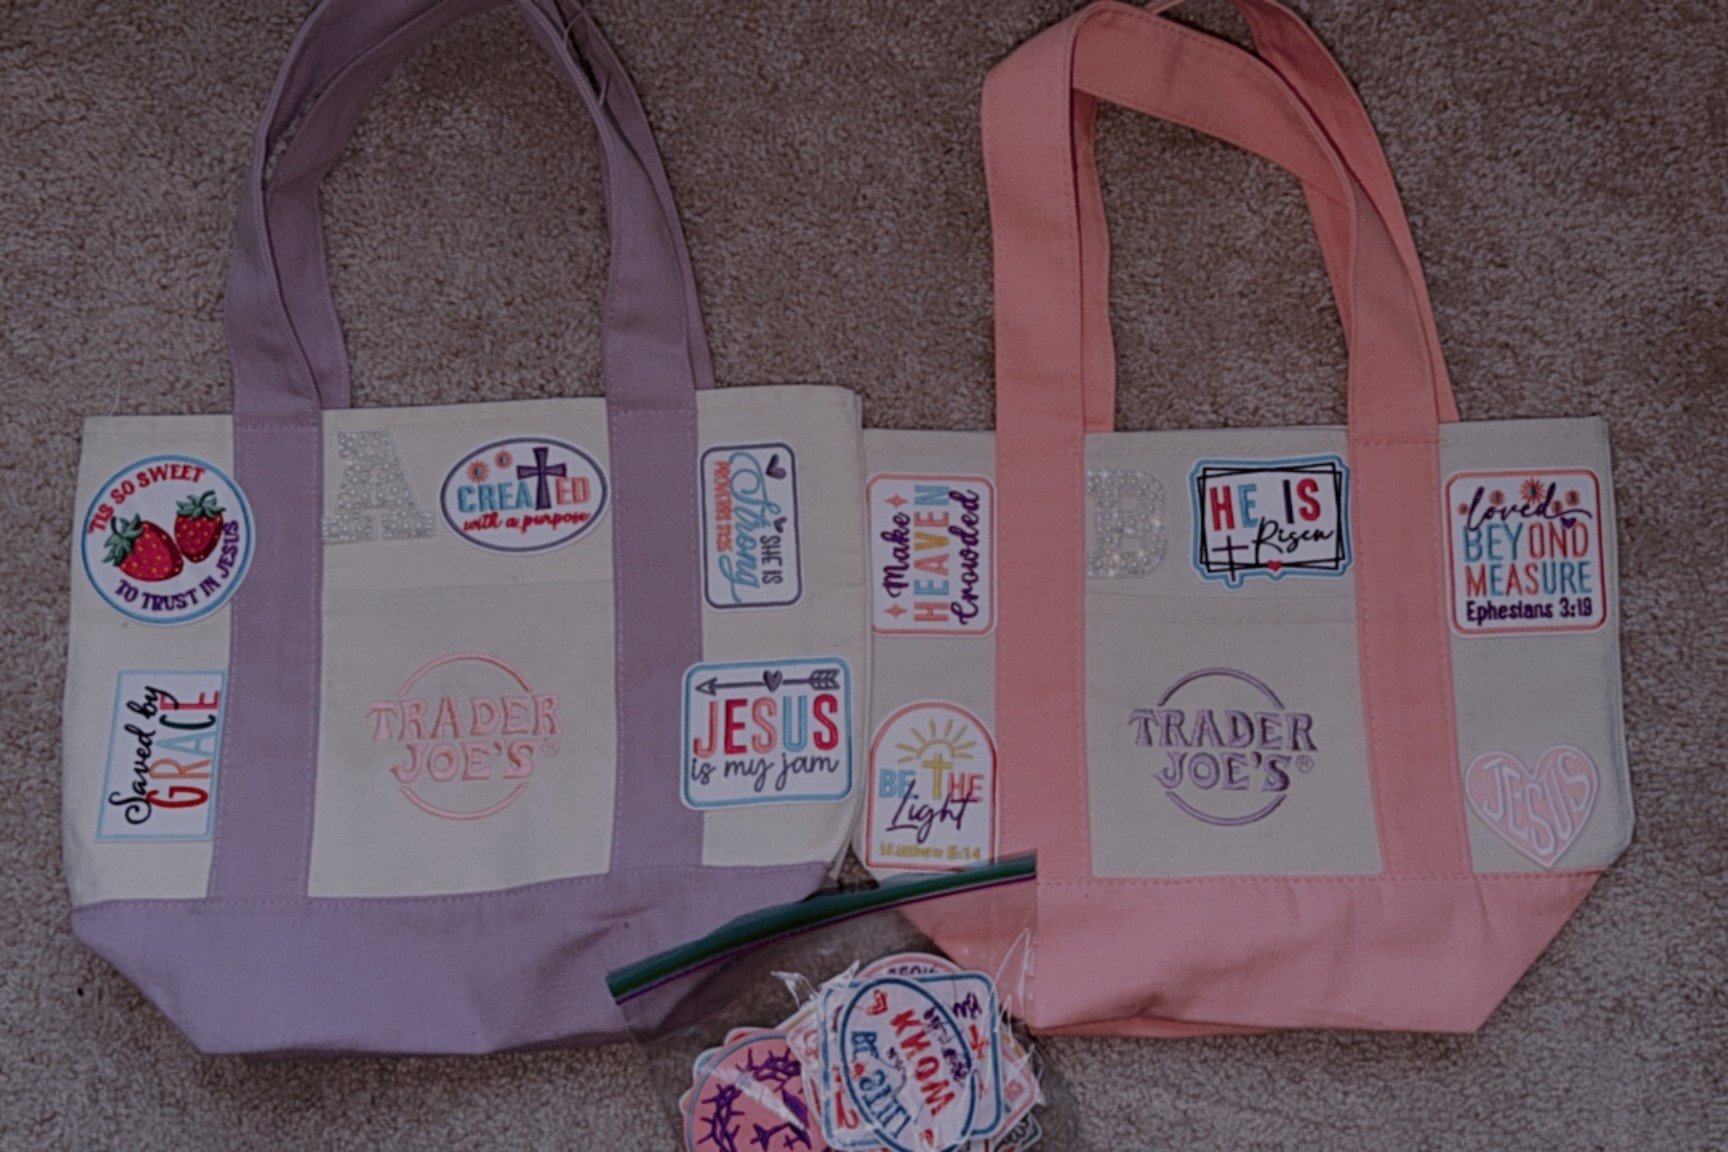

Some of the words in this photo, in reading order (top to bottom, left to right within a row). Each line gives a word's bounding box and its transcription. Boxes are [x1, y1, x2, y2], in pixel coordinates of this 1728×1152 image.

[110, 479, 135, 504] SO
[136, 463, 205, 488] SWEET
[457, 447, 590, 514] CREATED
[1209, 483, 1259, 531] HE
[1282, 478, 1321, 524] IS
[463, 511, 498, 531] with
[505, 516, 519, 528] a
[522, 511, 588, 534] purpose
[719, 451, 781, 603] Strong
[1086, 469, 1165, 579] B
[1468, 482, 1593, 532] loved
[115, 579, 138, 602] TO
[141, 588, 199, 611] TRUST
[200, 576, 221, 597] IN
[220, 519, 239, 578] JESUS
[760, 535, 783, 566] SHE
[880, 512, 910, 597] Make
[914, 485, 949, 621] HEAVEN
[948, 490, 980, 625] Crowded
[1252, 516, 1333, 566] Risen
[1463, 521, 1589, 562] BEYOND
[761, 570, 783, 584] IS
[1464, 561, 1592, 597] MEASURE
[126, 686, 180, 719] by
[365, 693, 561, 740] TRADER
[693, 694, 839, 758] JESUS
[146, 691, 220, 808] GRACE
[1129, 708, 1318, 751] TRADER
[108, 724, 156, 824] Saved
[389, 740, 536, 783] JOE'S
[691, 758, 716, 785] is
[724, 758, 775, 792] my
[775, 752, 839, 791] jam
[879, 769, 919, 799] BE
[1153, 751, 1292, 792] JOE'S
[886, 778, 979, 844] Light
[1482, 752, 1590, 855] JESUS
